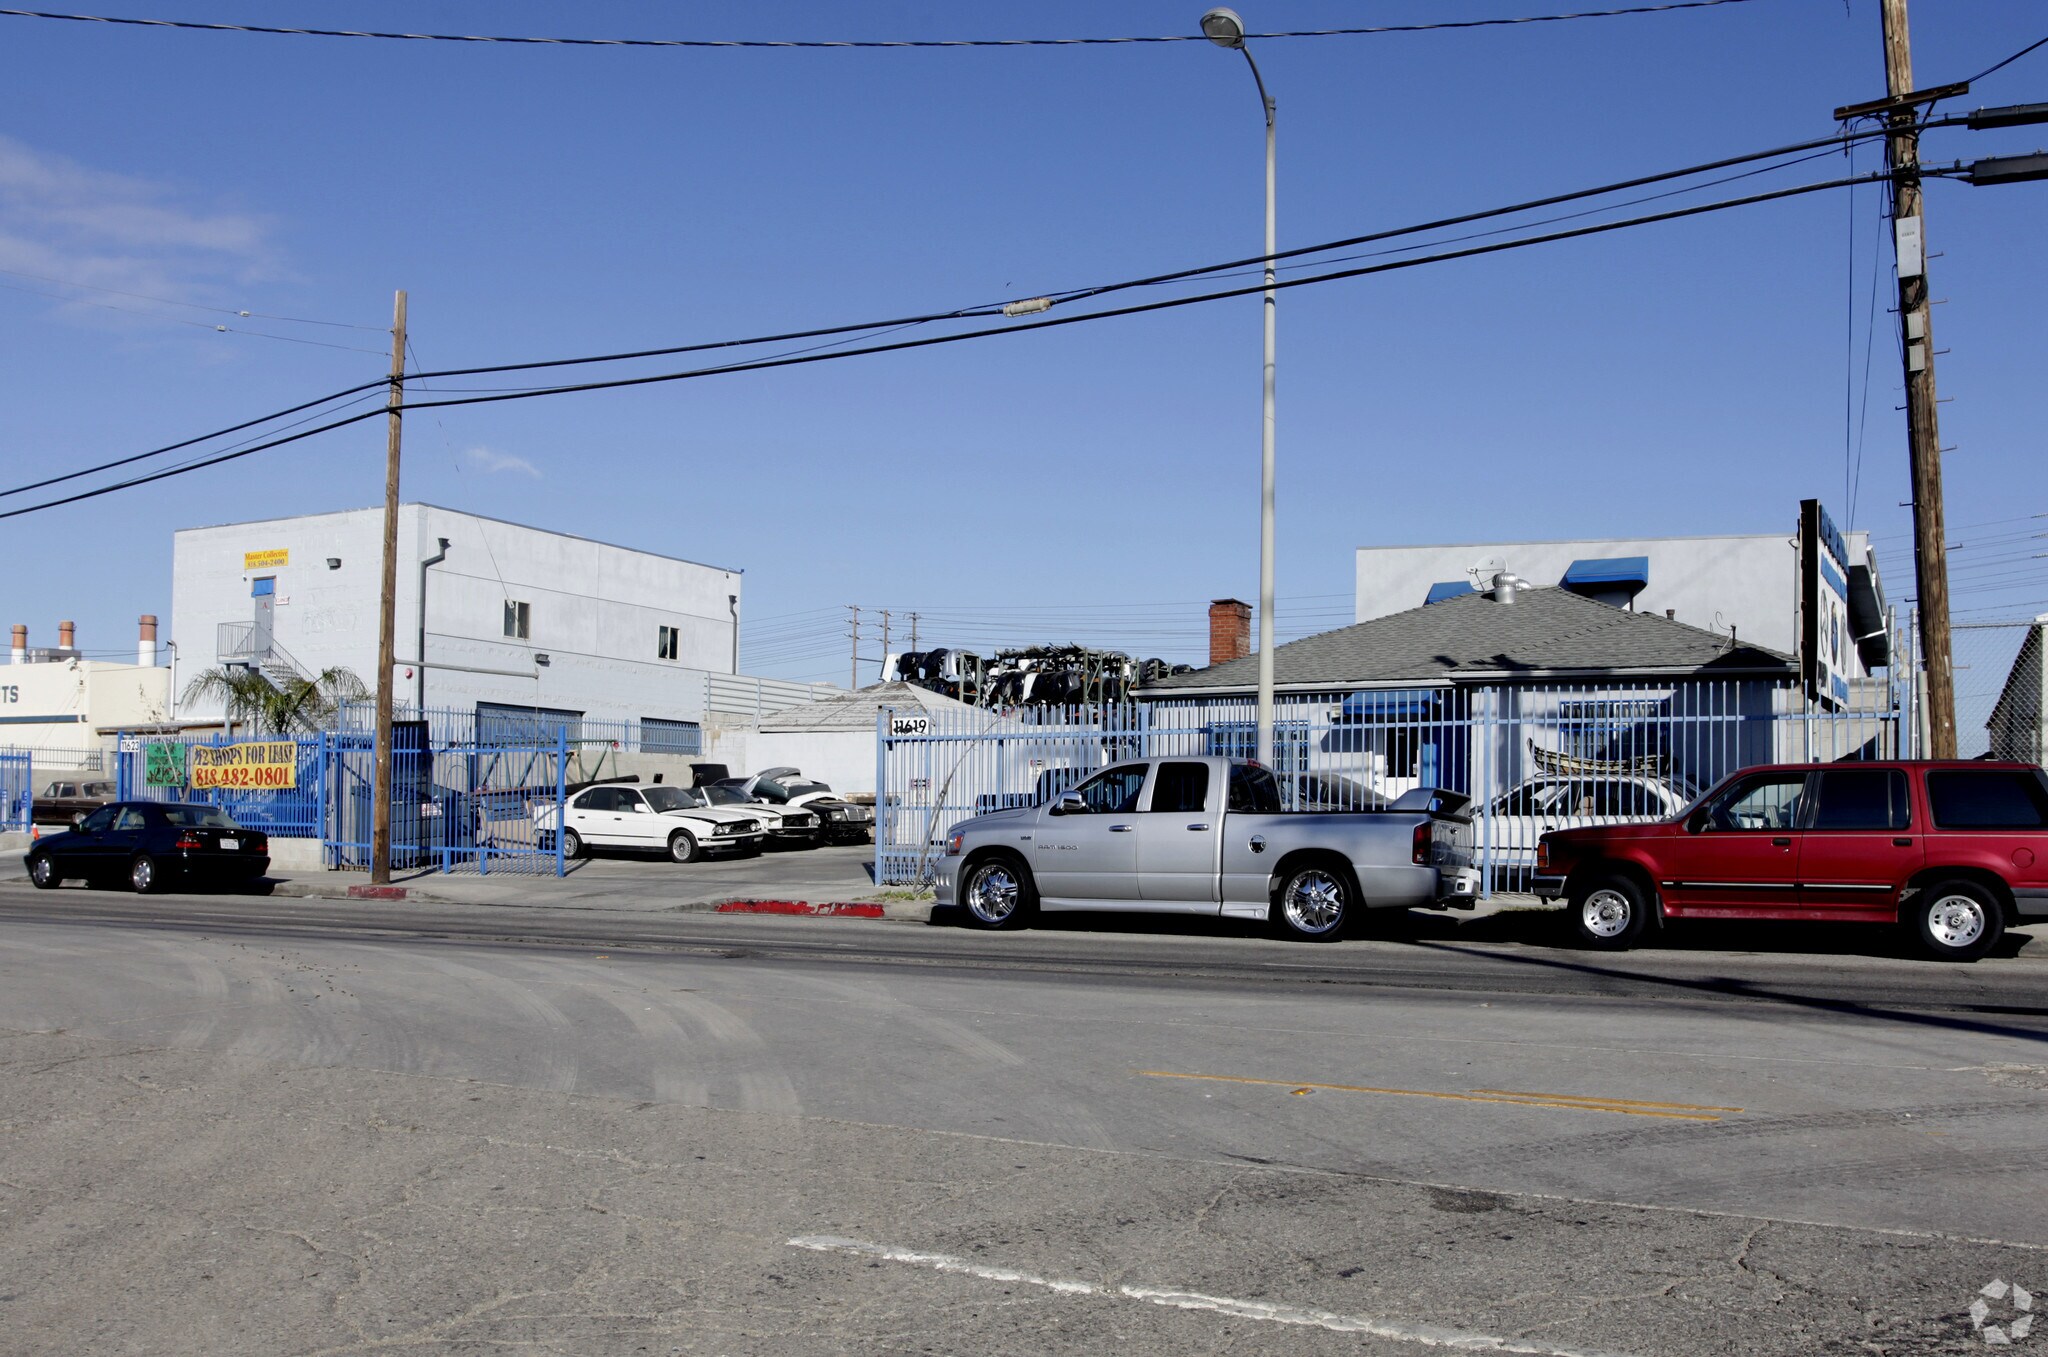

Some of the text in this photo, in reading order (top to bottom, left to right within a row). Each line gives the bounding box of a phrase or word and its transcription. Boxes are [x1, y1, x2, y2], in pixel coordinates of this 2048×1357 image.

[893, 719, 927, 734] 11619
[121, 740, 140, 751] 11623
[210, 747, 243, 766] SHOPS
[245, 745, 265, 764] FOR
[268, 744, 294, 764] LEASE
[196, 767, 289, 785] 818.482-0801
